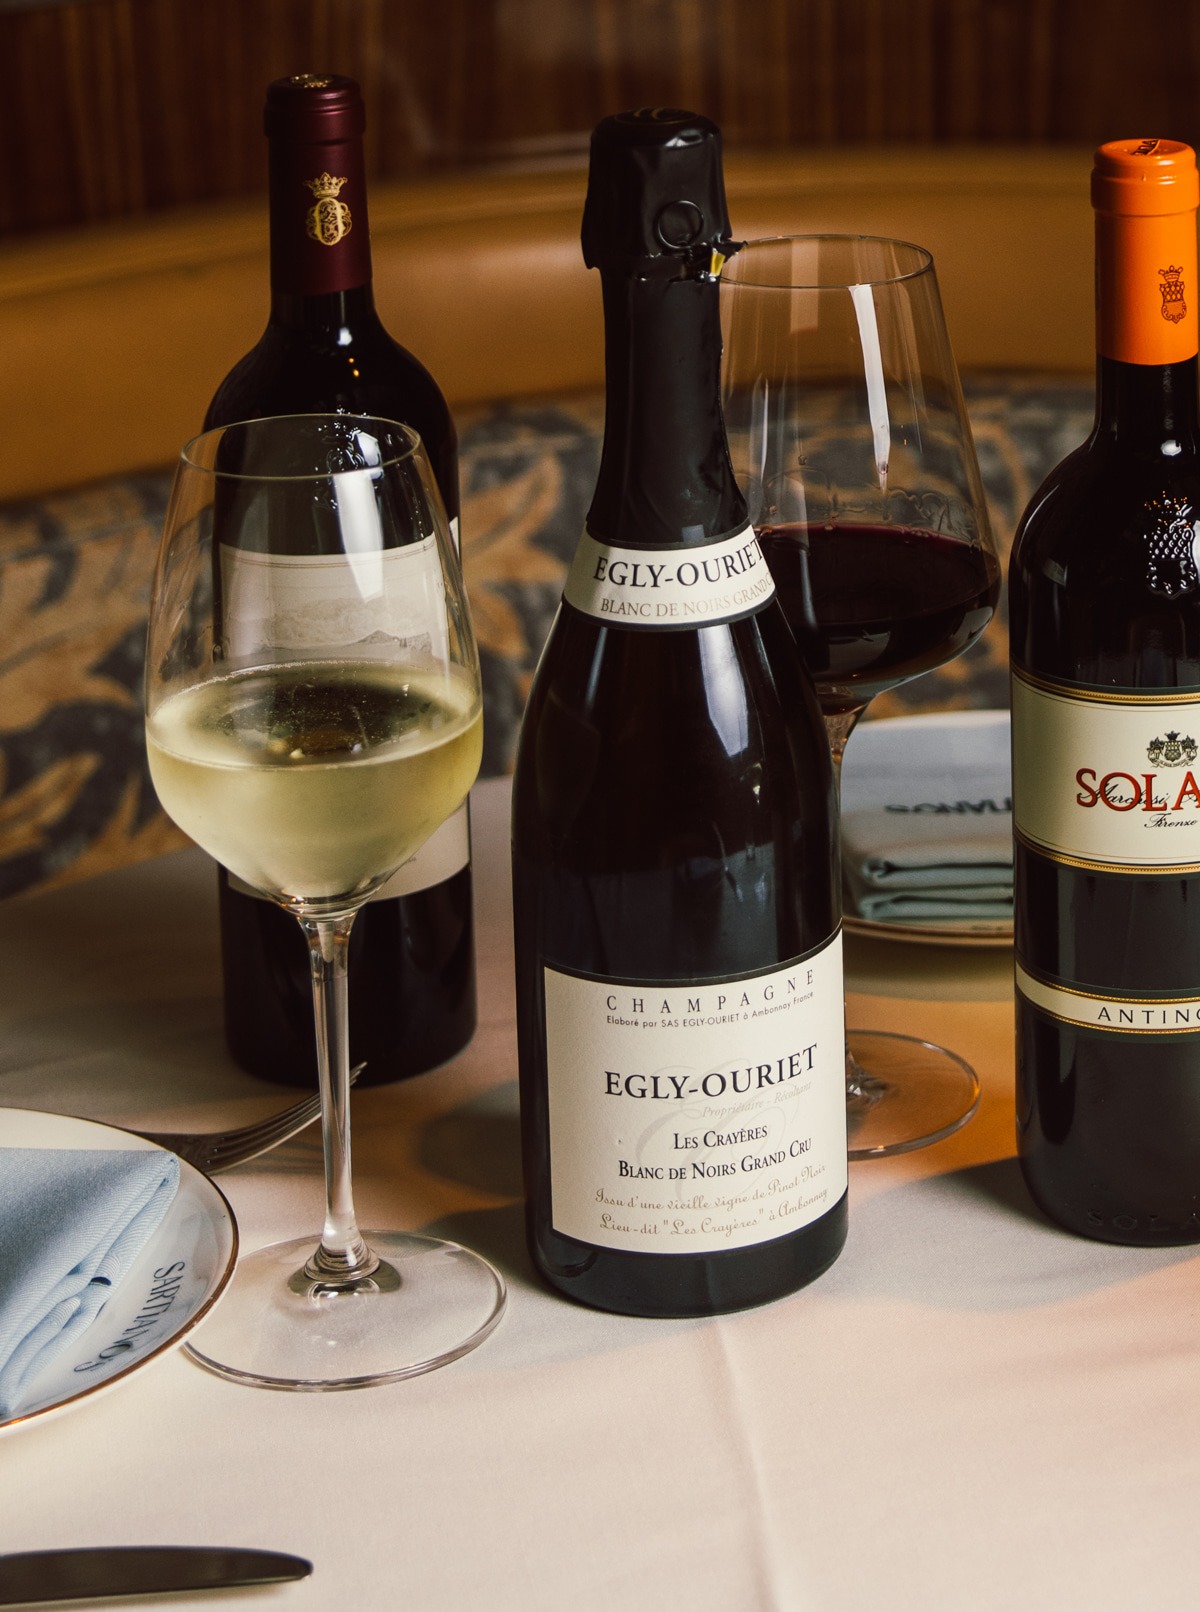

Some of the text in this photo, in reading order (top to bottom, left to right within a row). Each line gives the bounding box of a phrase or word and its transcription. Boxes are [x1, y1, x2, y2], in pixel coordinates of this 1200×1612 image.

[594, 538, 763, 588] EGLY-OURIET
[600, 598, 650, 617] BLANC
[656, 603, 679, 617] DE
[683, 594, 731, 616] NOIRS
[733, 578, 768, 605] GRAND
[1144, 812, 1198, 828] Firenze
[606, 969, 814, 1014] CHAMPAGNE
[607, 991, 814, 1029] Elaboré par SAS EGLY-OURIET à Ambonnay France
[604, 1043, 818, 1099] EGLY-OURIET
[618, 1138, 812, 1180] BLANC DE NOIRS GRAND CRU
[673, 1133, 699, 1150] LES
[667, 1195, 710, 1210] vieille
[715, 1196, 749, 1212] vigne
[752, 1188, 767, 1200] de
[767, 1178, 801, 1197] Pinot
[800, 1163, 826, 1184] Noir
[768, 1210, 776, 1220] à
